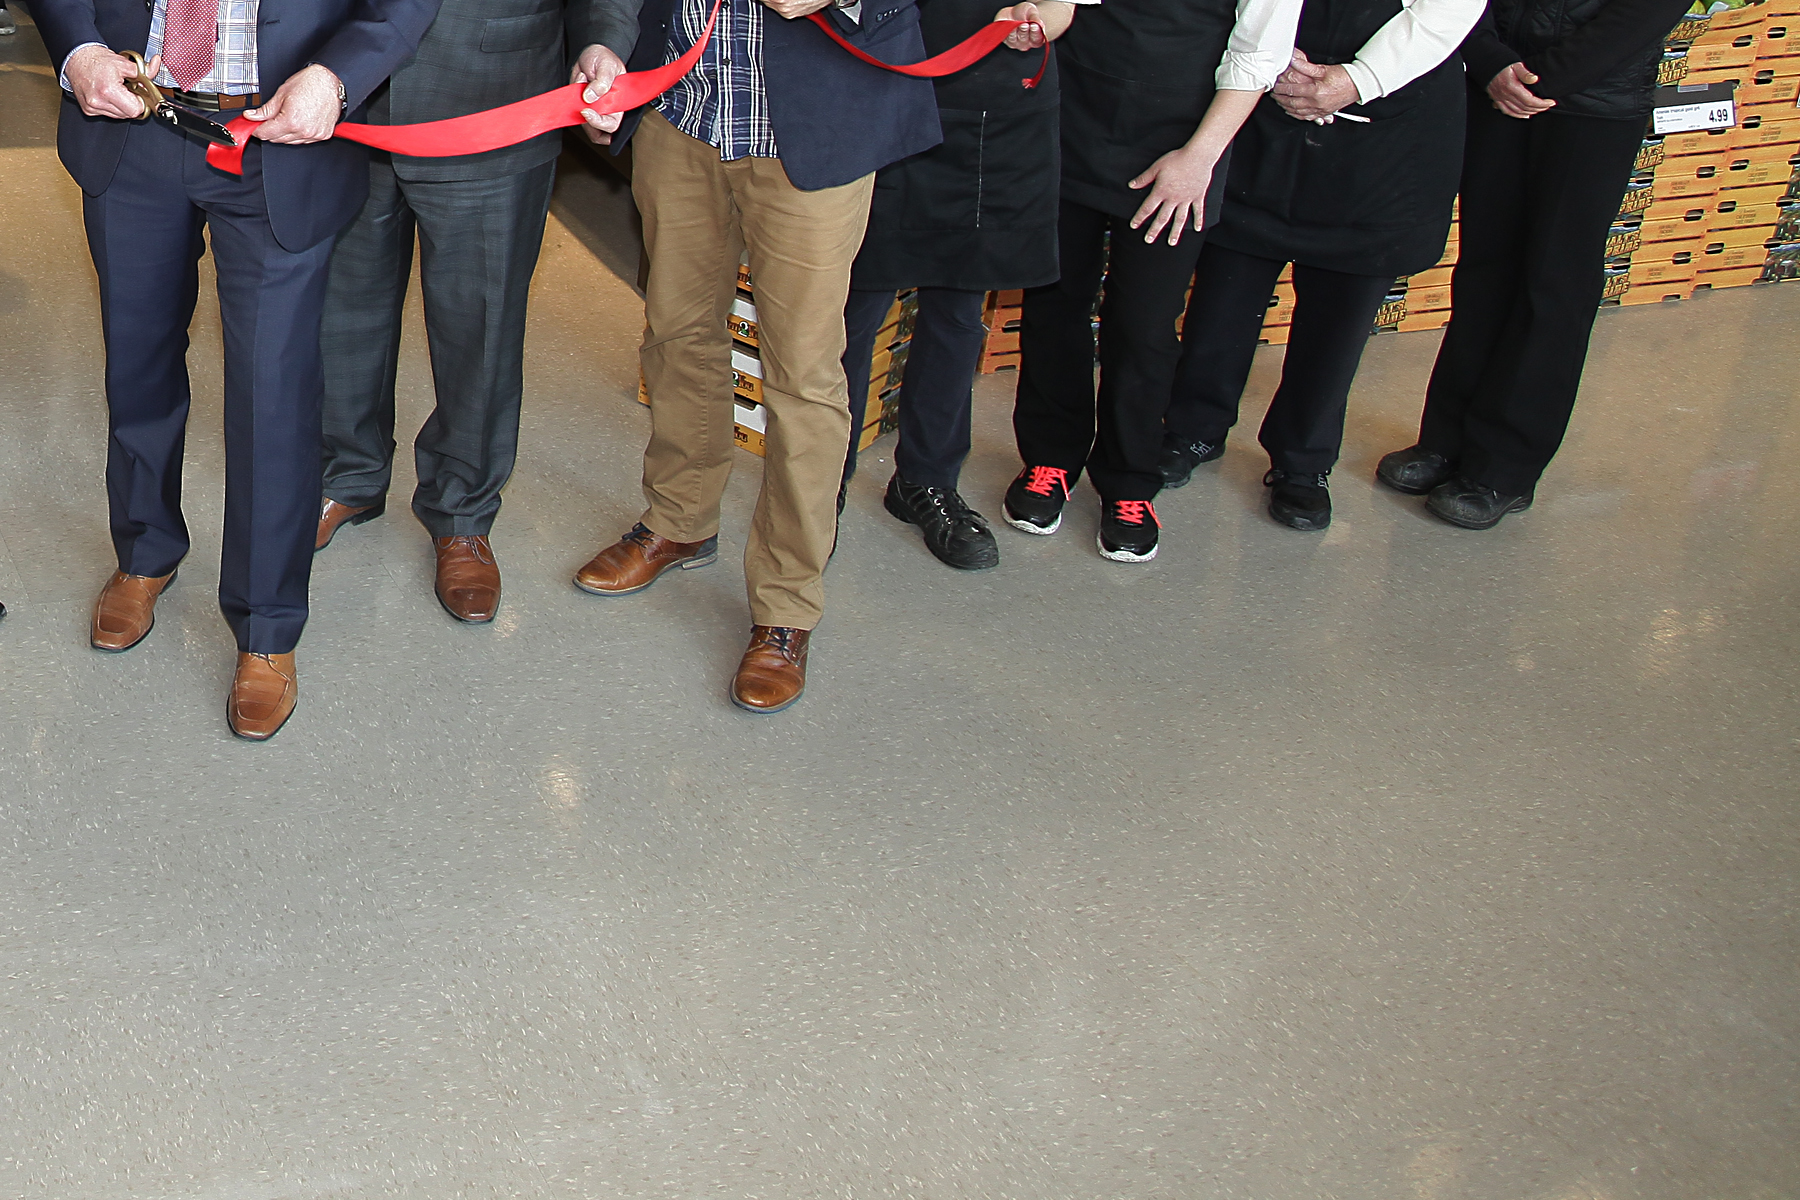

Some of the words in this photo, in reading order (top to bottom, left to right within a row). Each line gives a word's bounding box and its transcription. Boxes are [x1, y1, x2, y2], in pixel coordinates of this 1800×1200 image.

[1709, 109, 1728, 123] 4.99
[1604, 240, 1641, 258] PRIME
[1603, 281, 1630, 298] RIME
